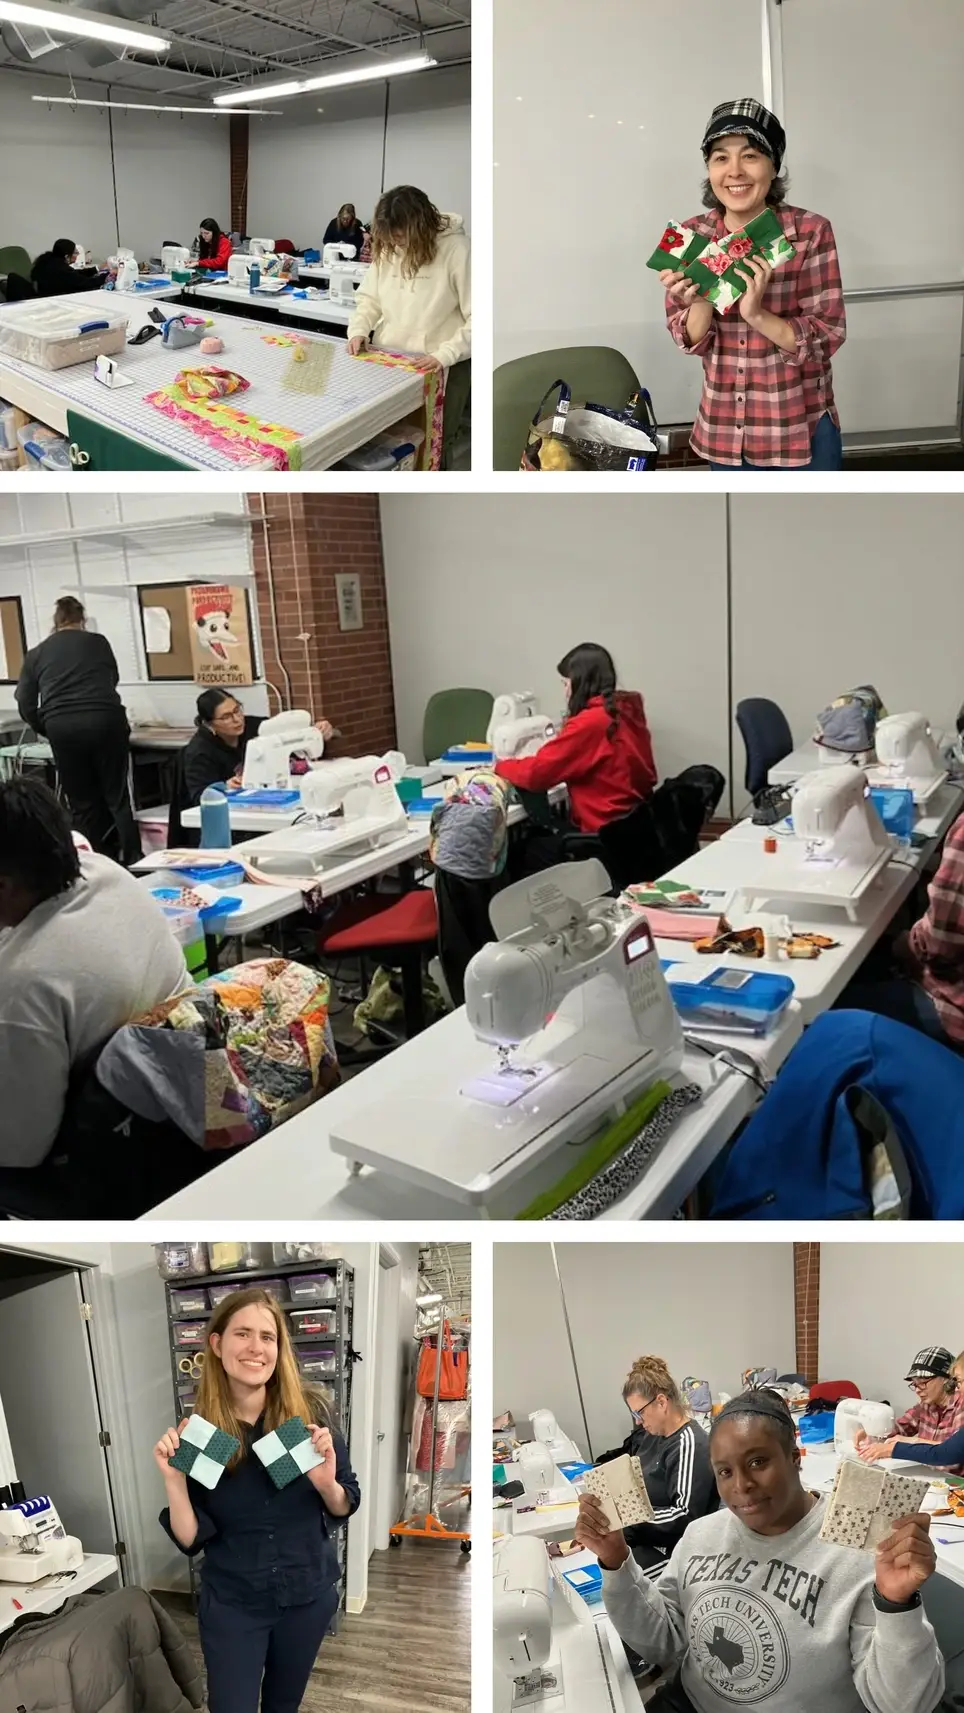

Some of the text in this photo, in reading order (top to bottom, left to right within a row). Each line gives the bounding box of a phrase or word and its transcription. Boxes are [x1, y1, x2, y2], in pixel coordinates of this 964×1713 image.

[682, 1553, 827, 1628] TEXAS TECH
[698, 1596, 731, 1617] TECH
[735, 1599, 776, 1688] UNIVERSITY
